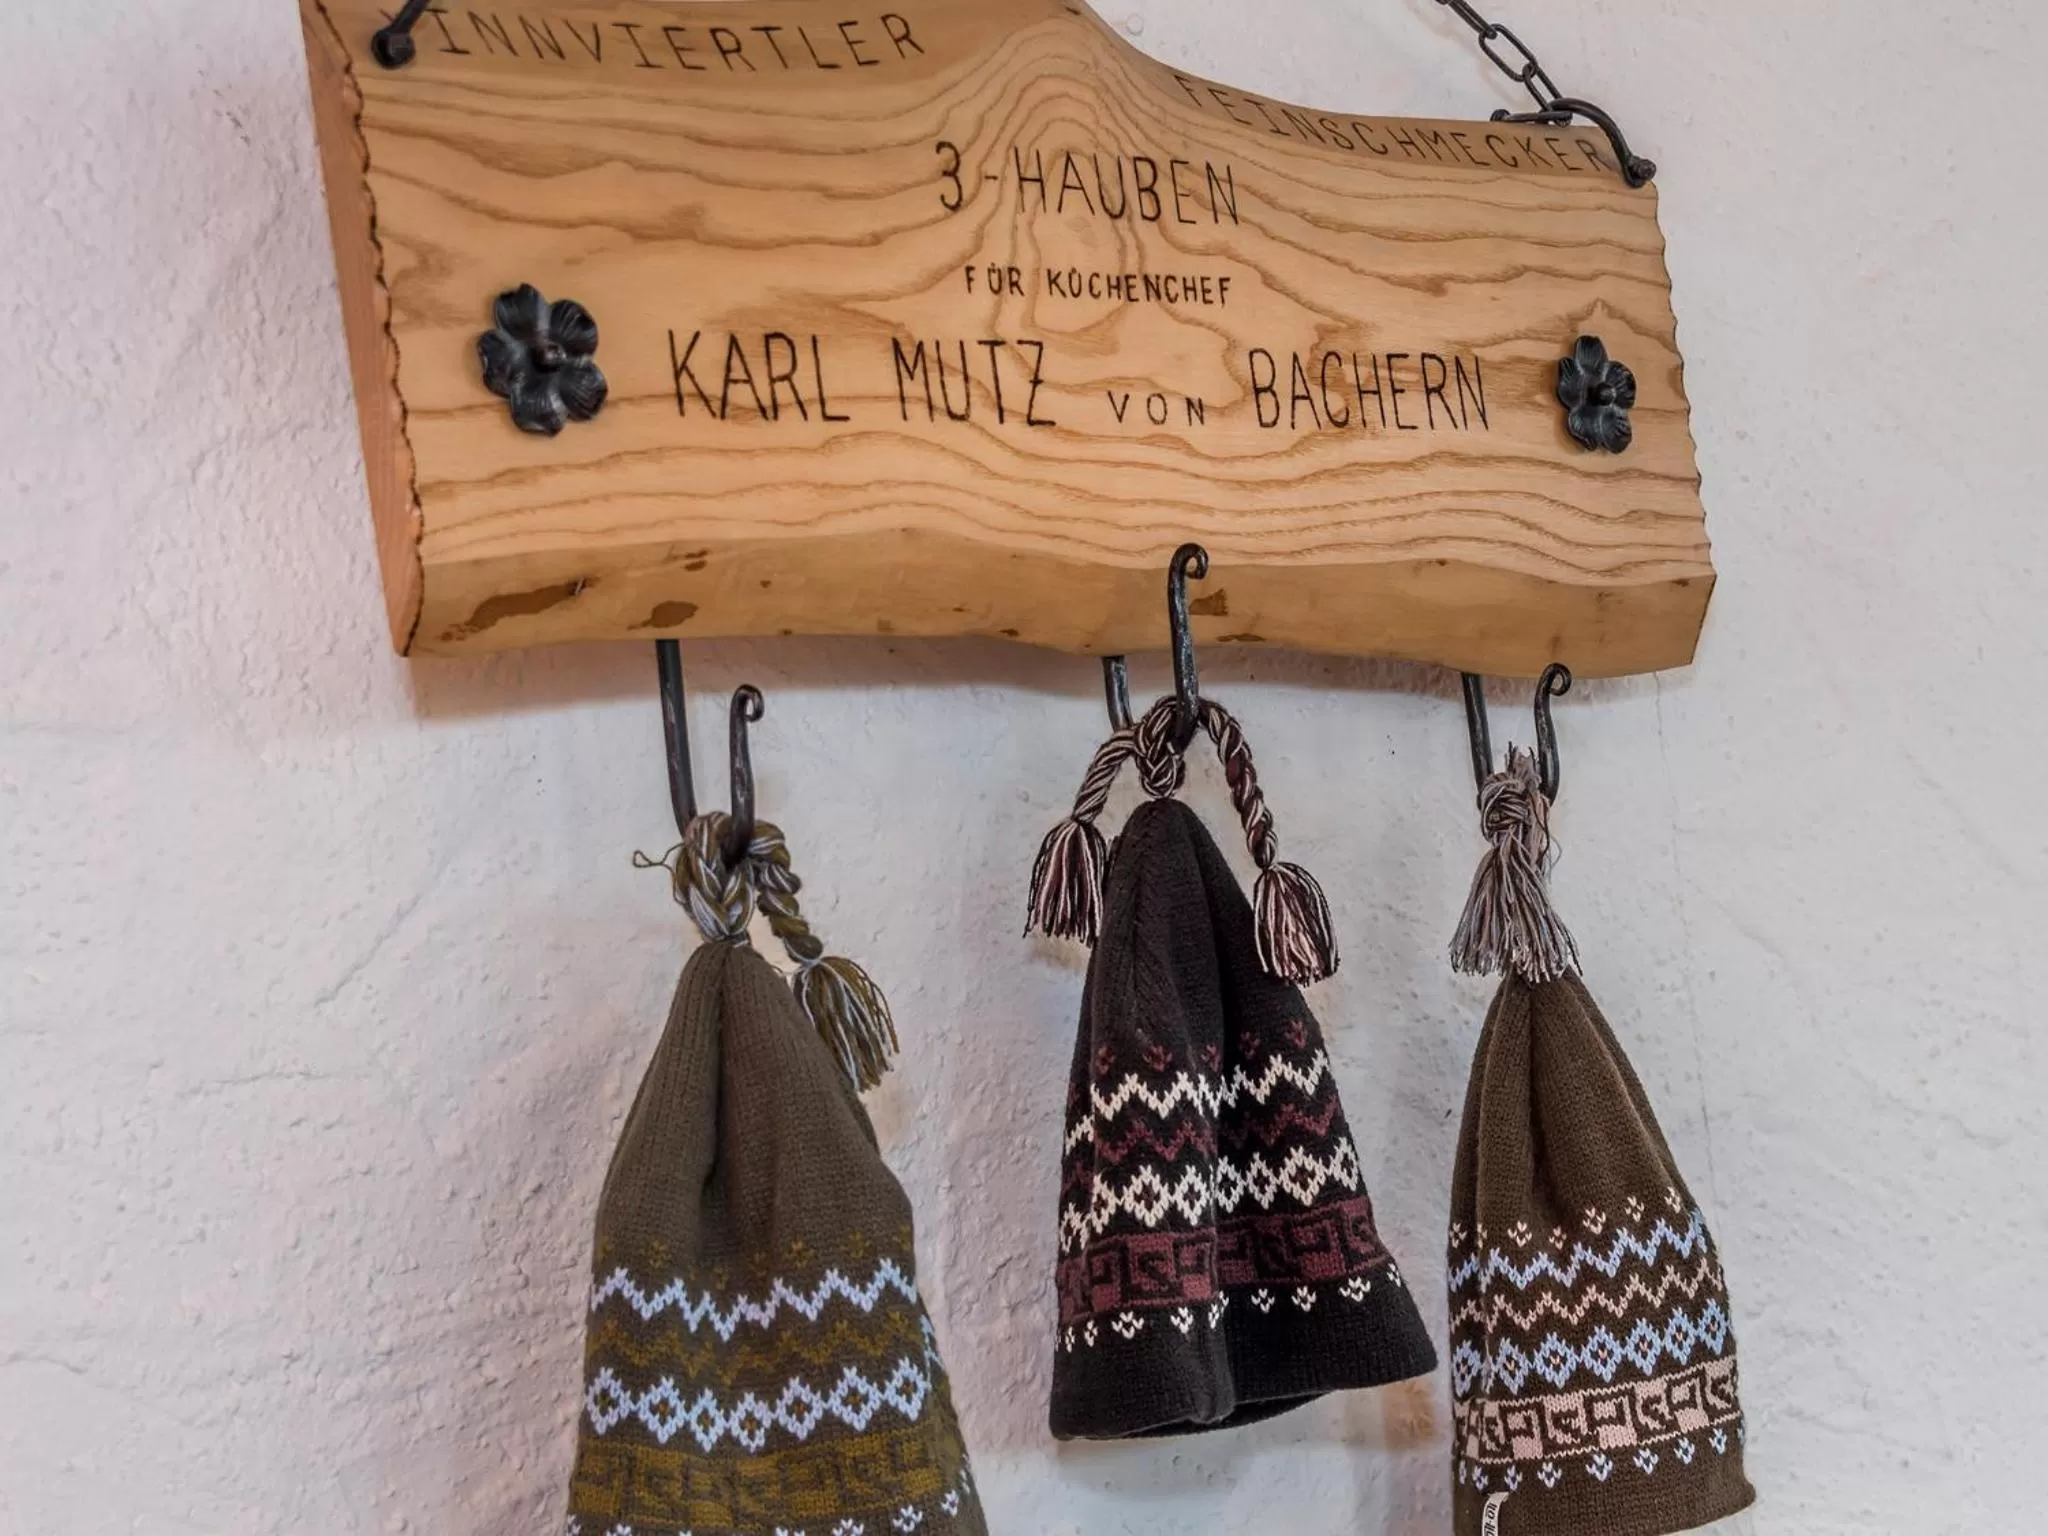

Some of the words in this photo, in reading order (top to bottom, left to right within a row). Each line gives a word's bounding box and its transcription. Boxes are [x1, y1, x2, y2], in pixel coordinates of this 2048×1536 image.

[423, 7, 926, 72] INNVIERTLER
[1173, 74, 1614, 173] FEINSCHMECKER
[964, 261, 1025, 298] FÜR
[1047, 267, 1232, 307] KÜCHENCHEF
[668, 328, 850, 422] KARL
[892, 336, 1057, 427] MUTZ
[1107, 389, 1205, 427] VON
[1248, 347, 1490, 432] BACHERN
